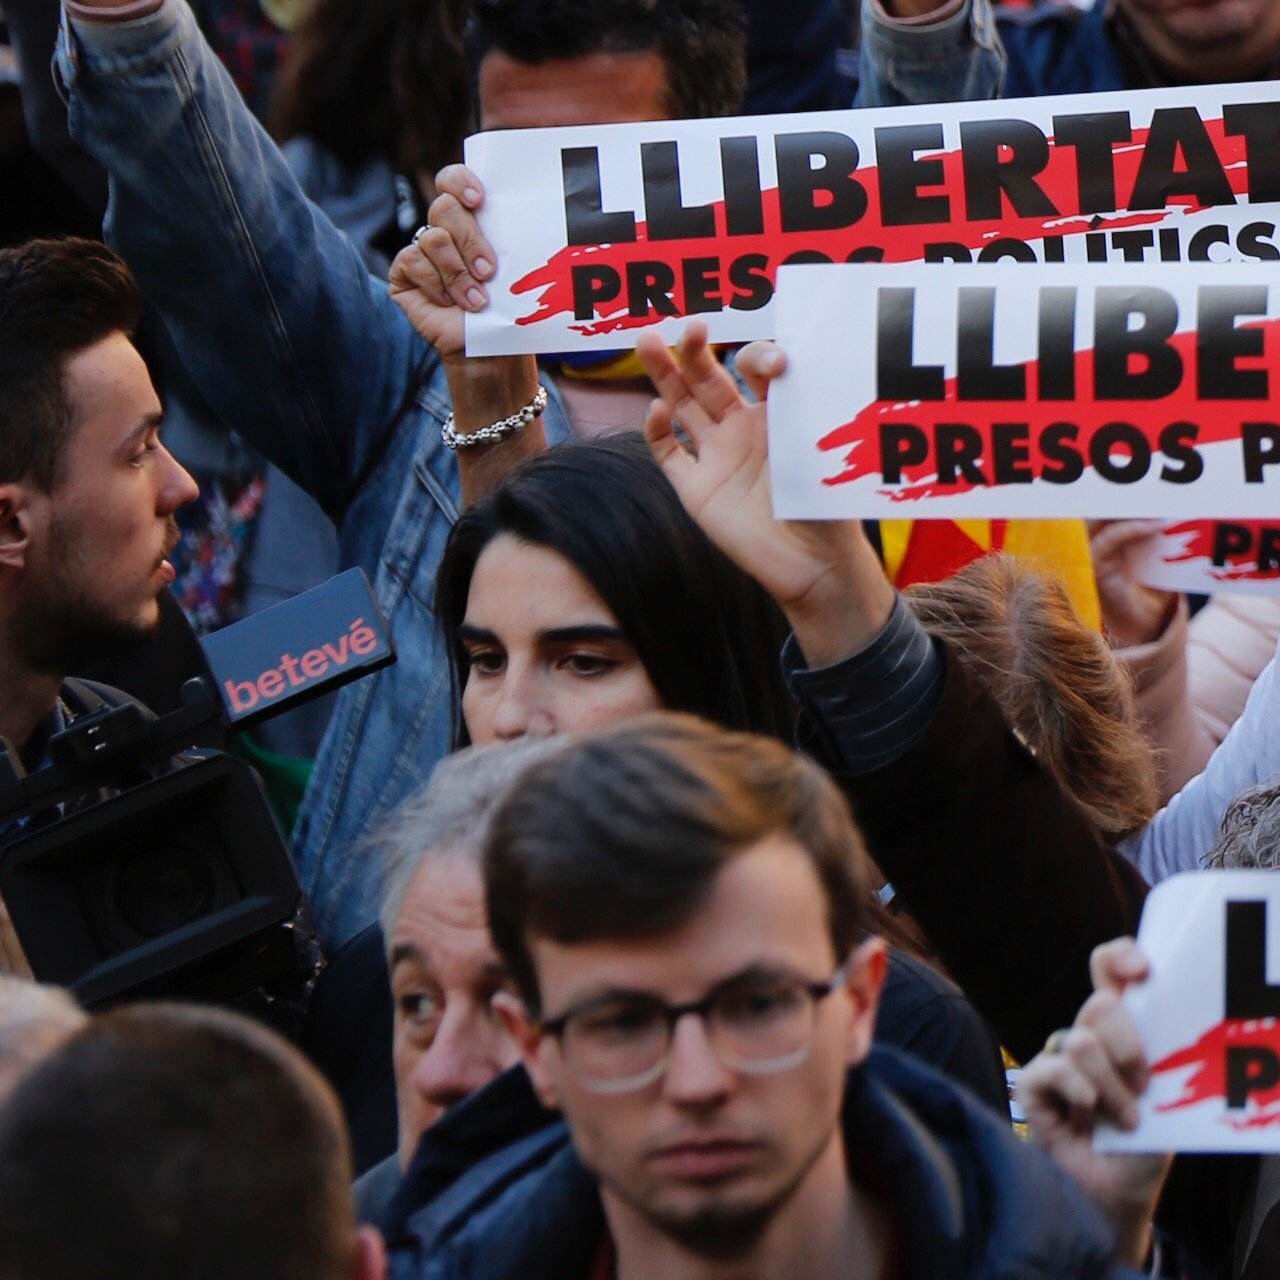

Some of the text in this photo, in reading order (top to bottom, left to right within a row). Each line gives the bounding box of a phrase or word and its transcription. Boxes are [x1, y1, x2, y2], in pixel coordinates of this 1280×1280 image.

[570, 245, 886, 322] PRES
[876, 419, 1206, 487] PRESOS
[223, 616, 379, 714] betevé
